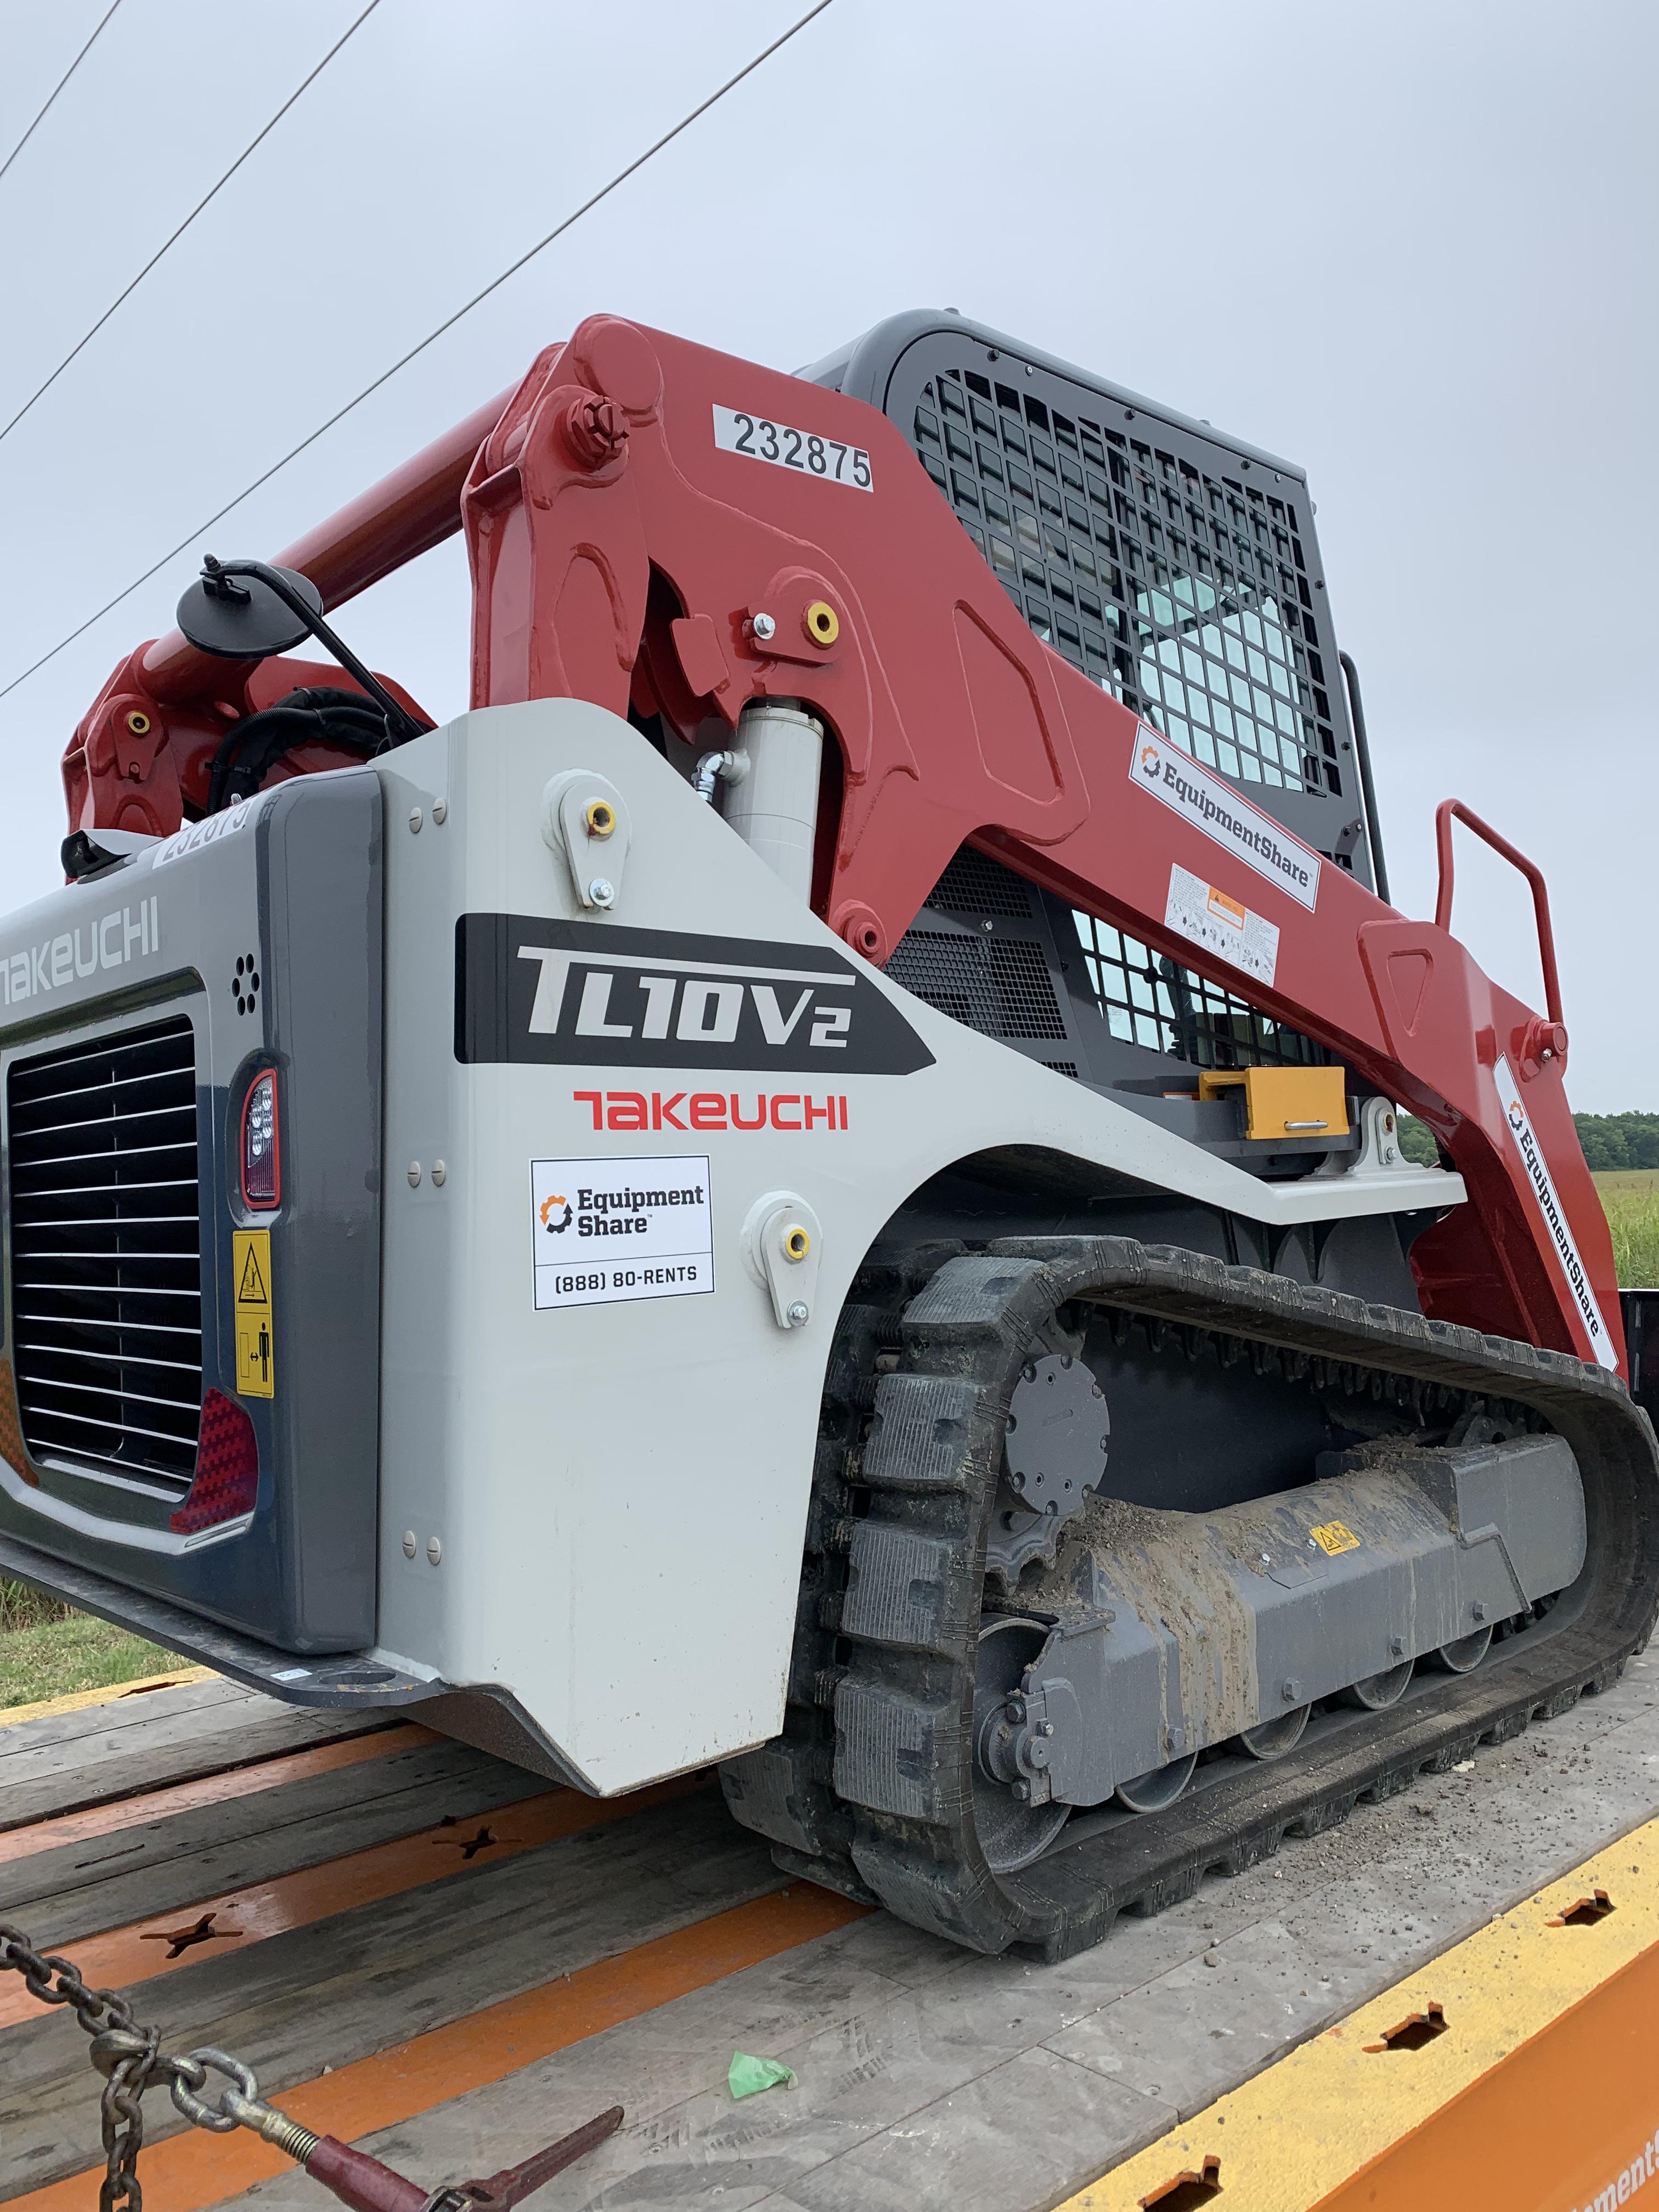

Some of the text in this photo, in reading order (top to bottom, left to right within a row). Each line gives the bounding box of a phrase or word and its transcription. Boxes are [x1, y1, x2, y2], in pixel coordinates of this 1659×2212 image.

[733, 413, 871, 487] 232875
[1163, 761, 1308, 887] EquipmentShare
[578, 1186, 704, 1214] Equipment
[1520, 1128, 1599, 1337] EquipmentShare
[555, 1266, 697, 1294] (888) 80-RENTS
